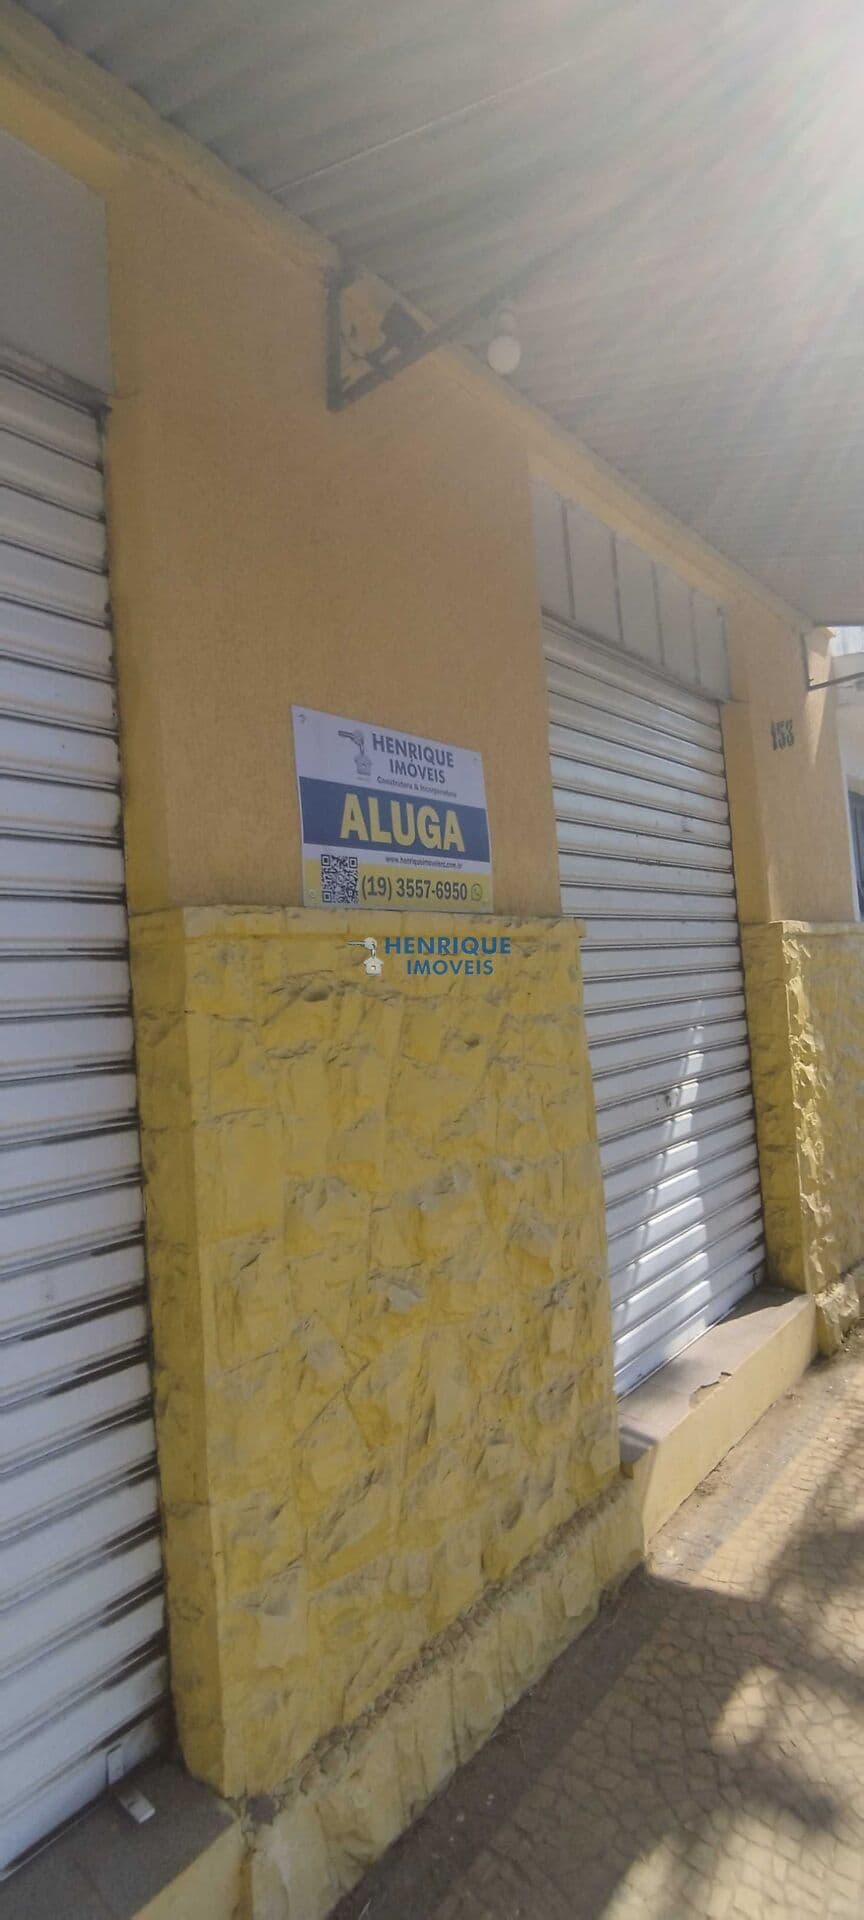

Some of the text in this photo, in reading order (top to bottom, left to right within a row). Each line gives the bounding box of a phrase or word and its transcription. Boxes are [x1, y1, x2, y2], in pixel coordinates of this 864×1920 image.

[372, 733, 455, 768] HENRIQUE
[389, 757, 446, 784] IMÓVEIS
[339, 793, 465, 853] ALUGA
[361, 875, 468, 901] (19) 3557-6950
